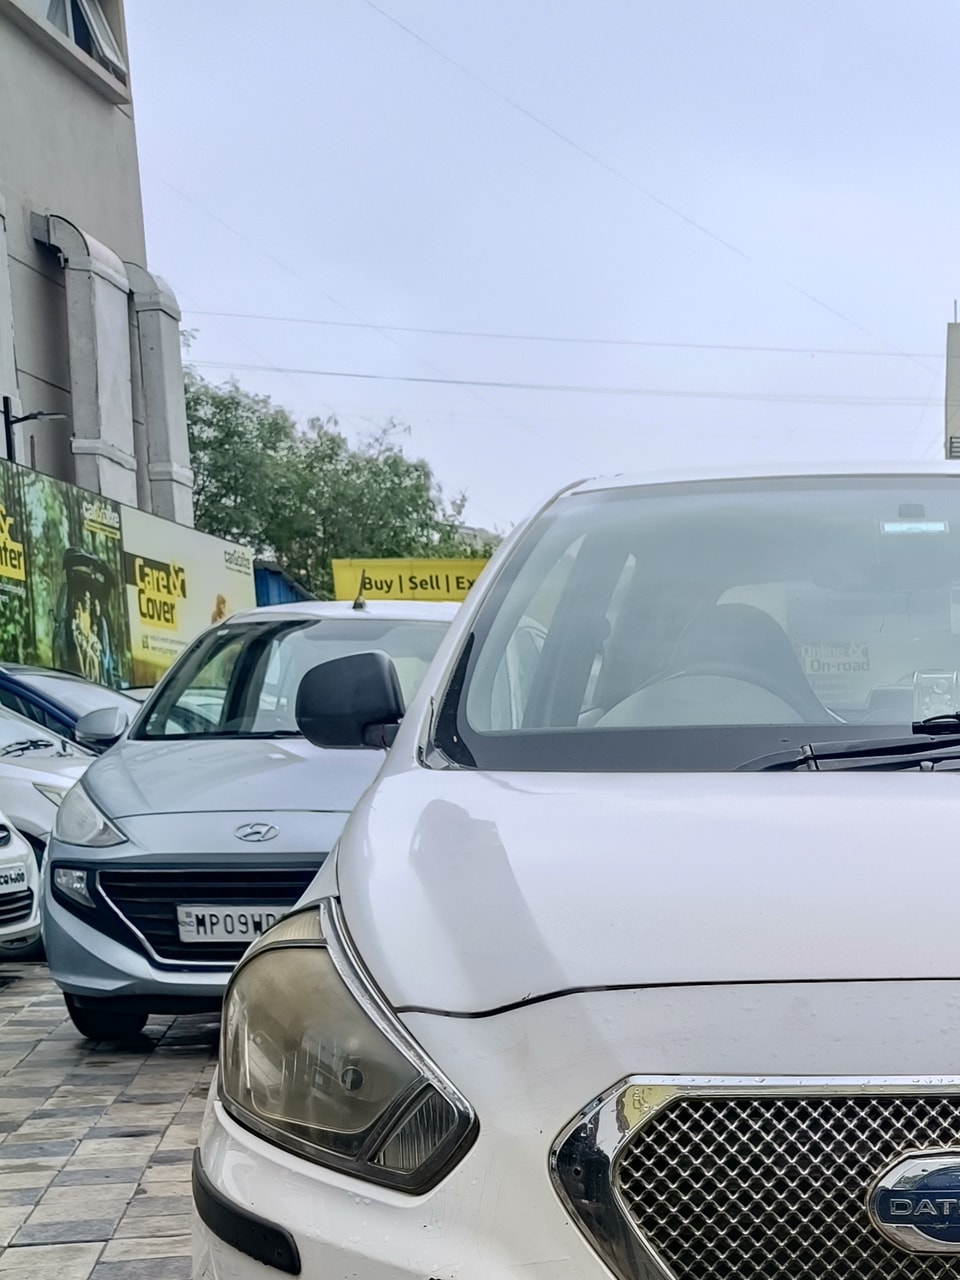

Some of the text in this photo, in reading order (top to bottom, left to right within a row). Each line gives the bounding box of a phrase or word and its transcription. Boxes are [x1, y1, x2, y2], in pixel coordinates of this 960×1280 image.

[135, 558, 167, 595] Care
[362, 573, 394, 594] Buy
[408, 574, 441, 591] Sell
[138, 588, 175, 624] Cover
[810, 658, 871, 673] On-road
